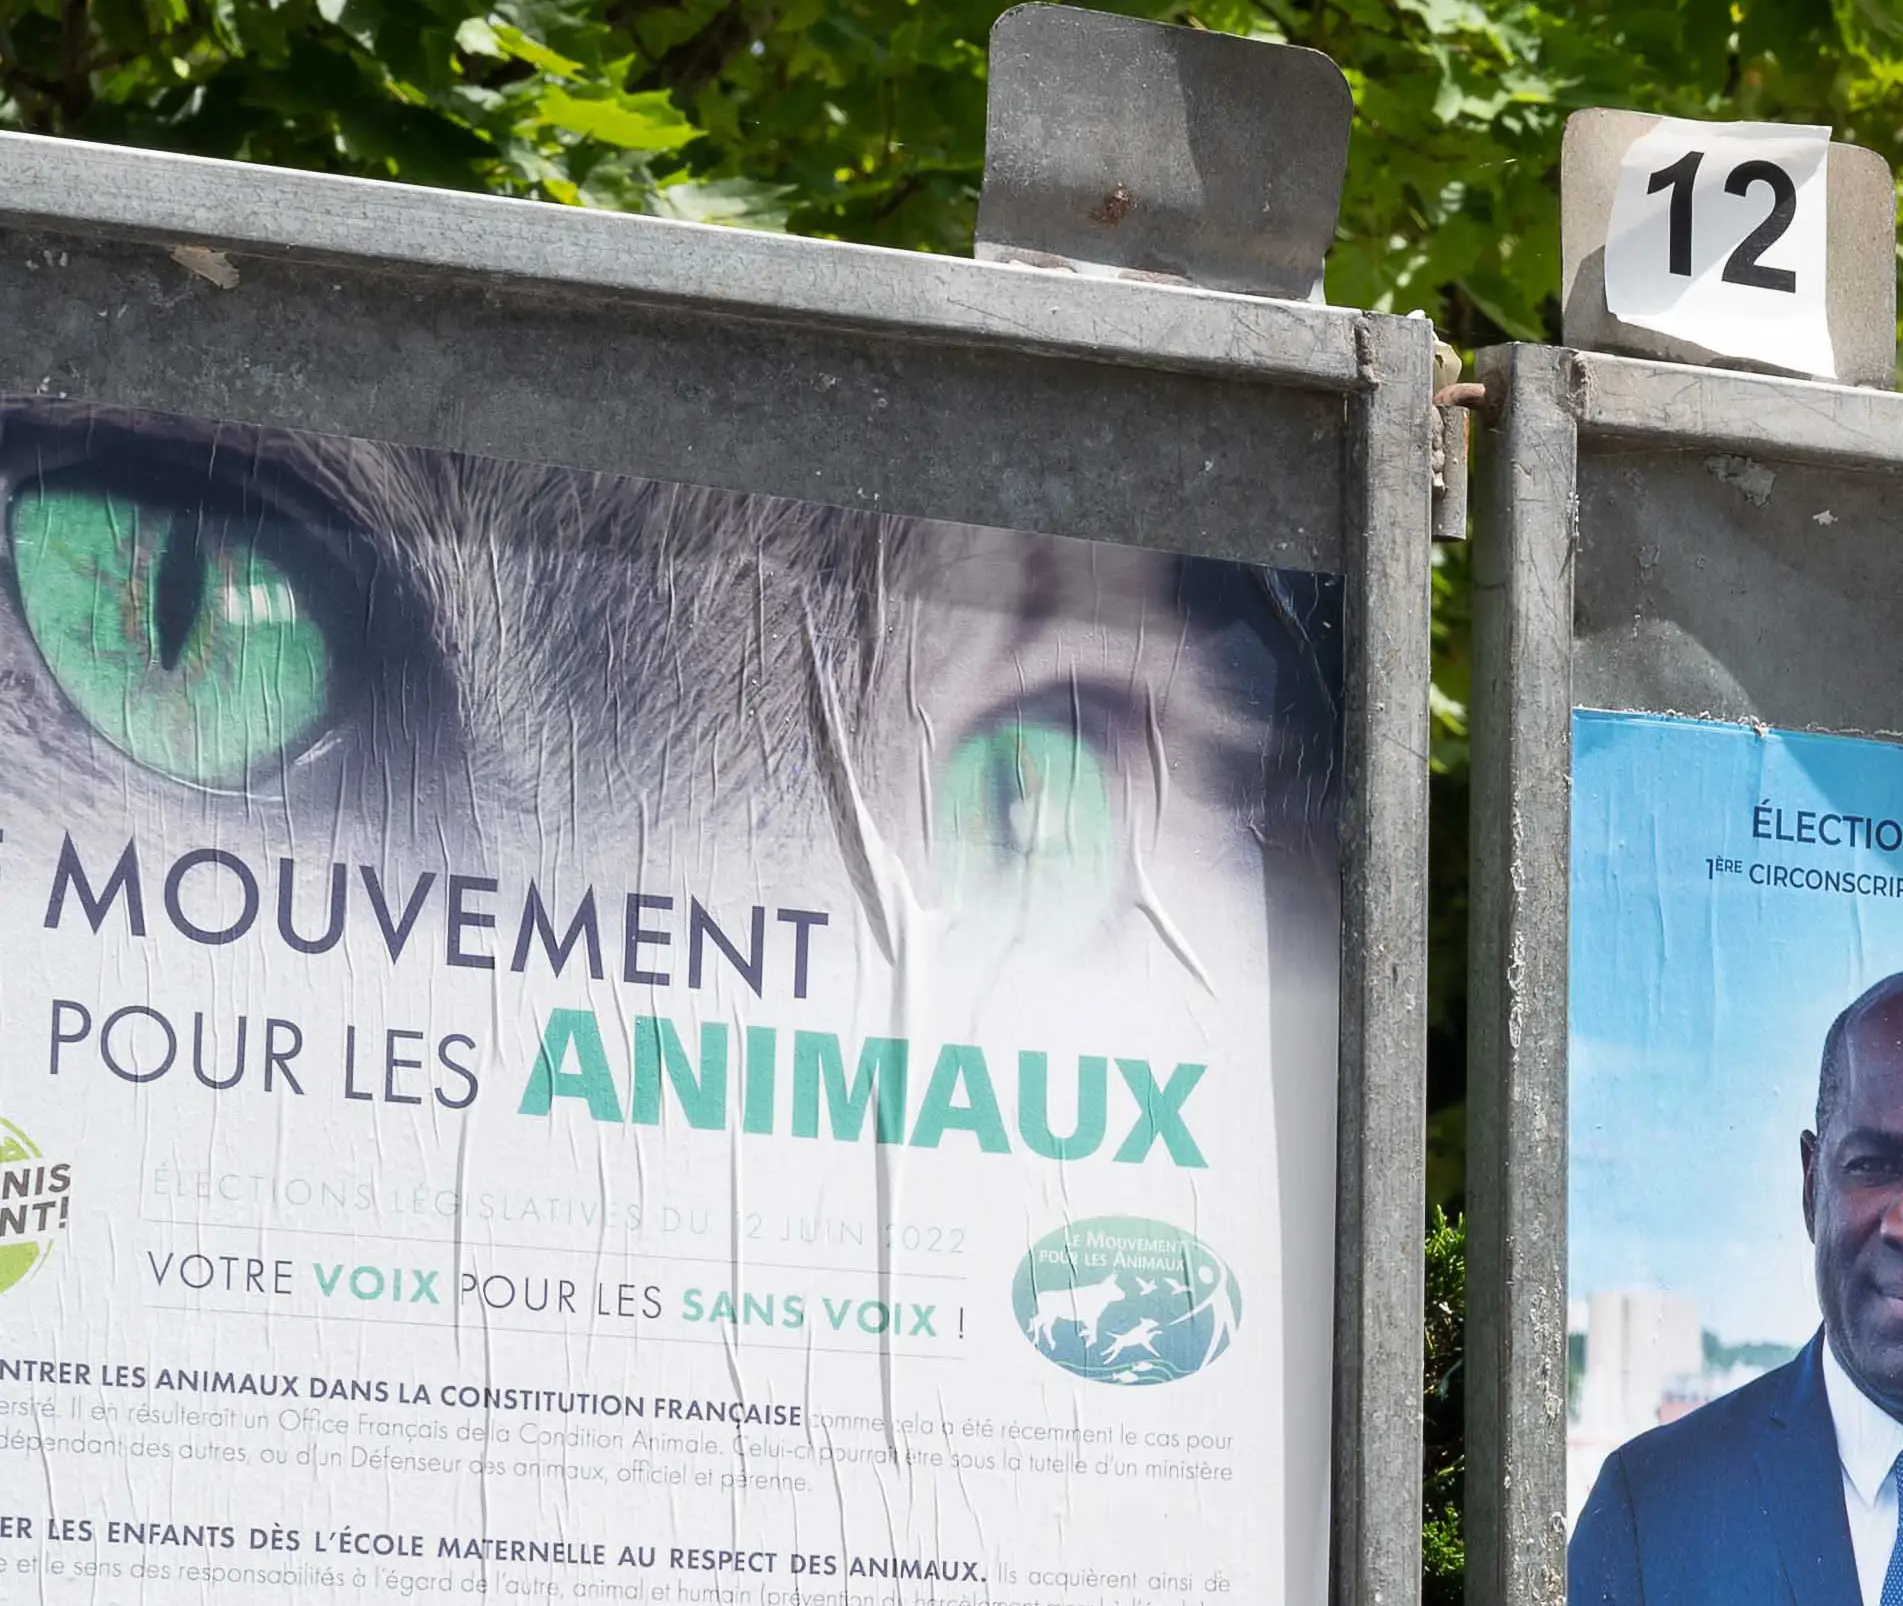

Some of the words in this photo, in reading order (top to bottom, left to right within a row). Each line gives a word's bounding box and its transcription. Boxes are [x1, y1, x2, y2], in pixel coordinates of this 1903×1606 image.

[1647, 151, 1796, 293] 12
[44, 829, 828, 999] MOUVEMENT
[1706, 856, 1742, 879] 1ÈRE
[50, 999, 304, 1095] POUR
[345, 1026, 478, 1109] LES
[517, 1008, 1209, 1168] ANIMAUX
[148, 1251, 292, 1294] VOTRE
[313, 1263, 439, 1304] VOIX
[462, 1274, 575, 1315] POUR
[599, 1283, 661, 1318] LES
[682, 1285, 804, 1334] SANS
[826, 1297, 937, 1338] VOIX
[103, 1365, 145, 1388] LES
[155, 1369, 299, 1397] ANIMAUX
[310, 1378, 388, 1402] DANS
[400, 1383, 431, 1404] LA
[441, 1386, 643, 1417] CONSTITUTION
[655, 1394, 801, 1430] FRANÇAISE
